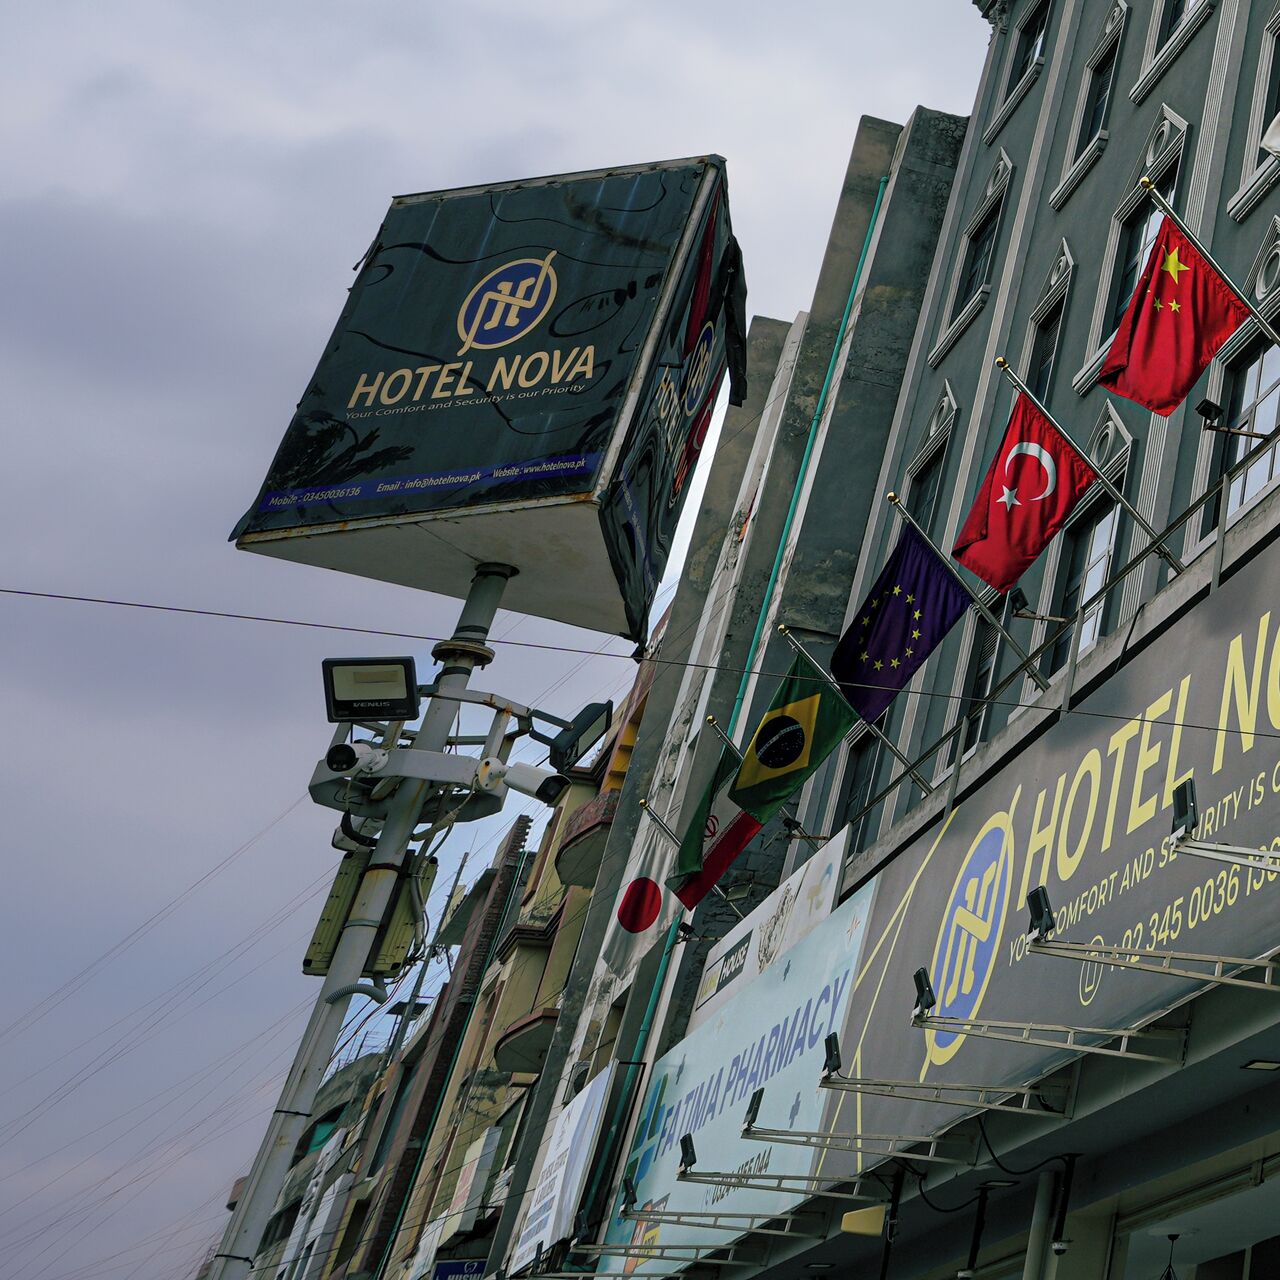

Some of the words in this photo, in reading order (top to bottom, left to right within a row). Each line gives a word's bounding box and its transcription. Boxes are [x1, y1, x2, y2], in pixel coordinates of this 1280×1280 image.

[346, 411, 373, 420] Your
[375, 405, 425, 417] Comfort
[428, 401, 452, 411] and
[455, 395, 504, 407] Security
[506, 392, 516, 401] is
[518, 390, 539, 400] our
[541, 384, 586, 397] Priority
[347, 361, 474, 408] HOTEL
[486, 345, 595, 392] NOVA
[268, 494, 298, 506] Mobile
[303, 487, 362, 502] 03450036136
[376, 481, 400, 493] Email
[404, 472, 482, 489] info@hotelnova.pk
[493, 467, 520, 478] Website
[523, 458, 586, 474] www.hotelnova.pk
[1016, 674, 1195, 912] HOTEL
[1119, 847, 1155, 895] AND
[1159, 786, 1243, 868] SEURITY
[1248, 772, 1265, 810] IS
[1146, 896, 1184, 958] 345
[1188, 864, 1240, 929] 0036
[654, 1066, 724, 1162] FATIMA
[719, 969, 850, 1116] PHARMACY
